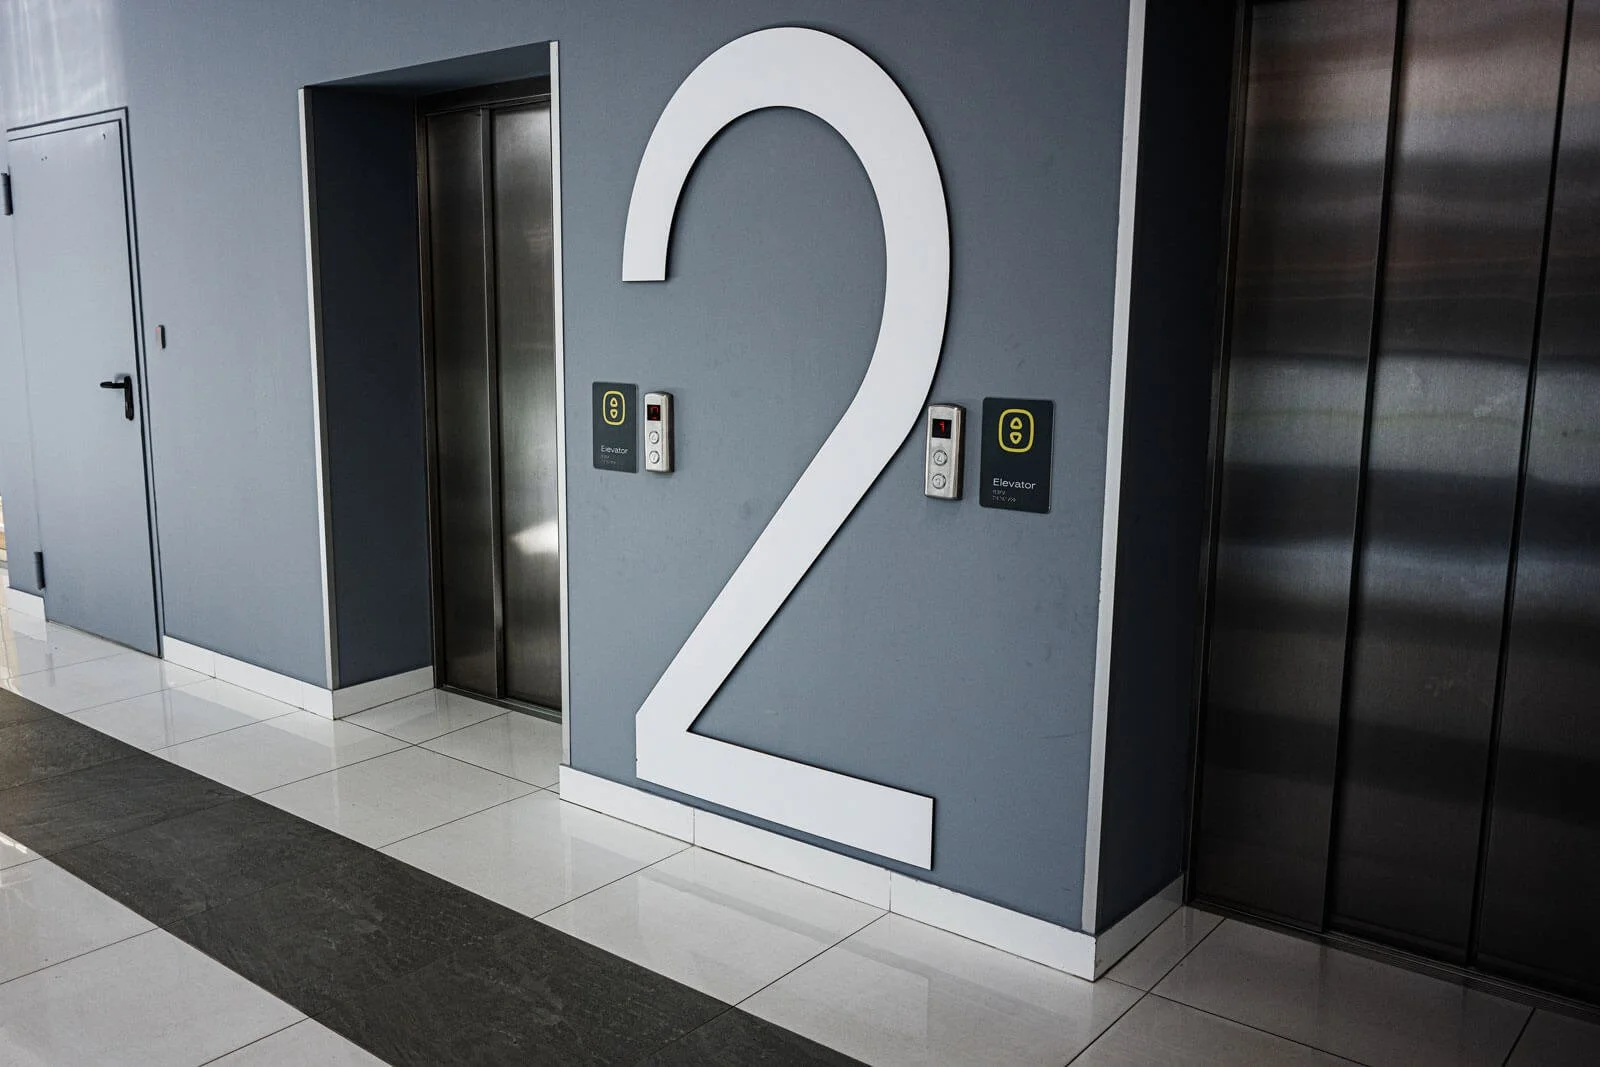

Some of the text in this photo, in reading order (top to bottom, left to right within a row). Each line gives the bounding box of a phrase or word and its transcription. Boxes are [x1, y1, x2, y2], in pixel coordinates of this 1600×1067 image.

[600, 445, 629, 455] Elevator
[622, 27, 950, 869] 2
[993, 477, 1036, 490] Elevator
